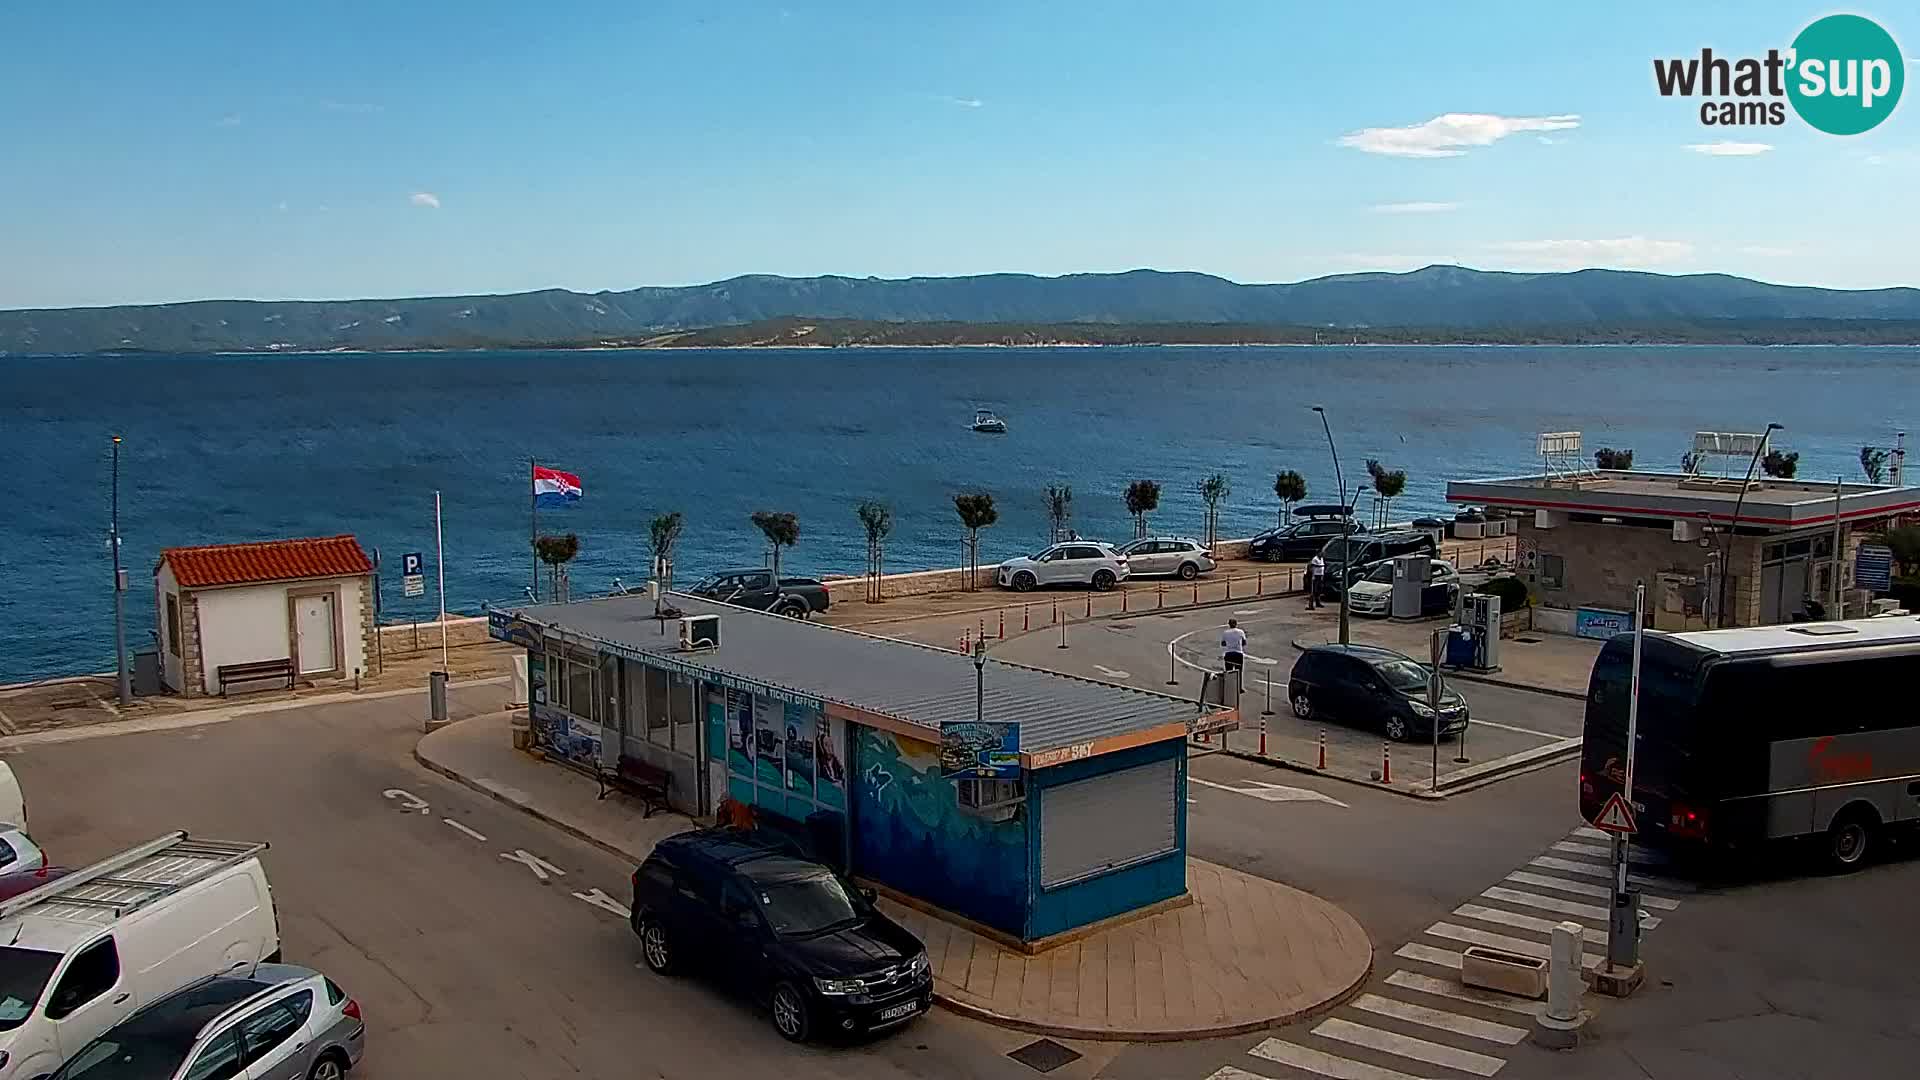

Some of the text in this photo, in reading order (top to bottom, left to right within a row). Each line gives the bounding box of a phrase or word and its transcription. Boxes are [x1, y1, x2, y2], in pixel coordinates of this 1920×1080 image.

[407, 556, 418, 573] P
[721, 676, 735, 687] BUS
[737, 680, 767, 697] STATION
[769, 688, 794, 703] TICKET
[795, 695, 820, 710] OFFICE
